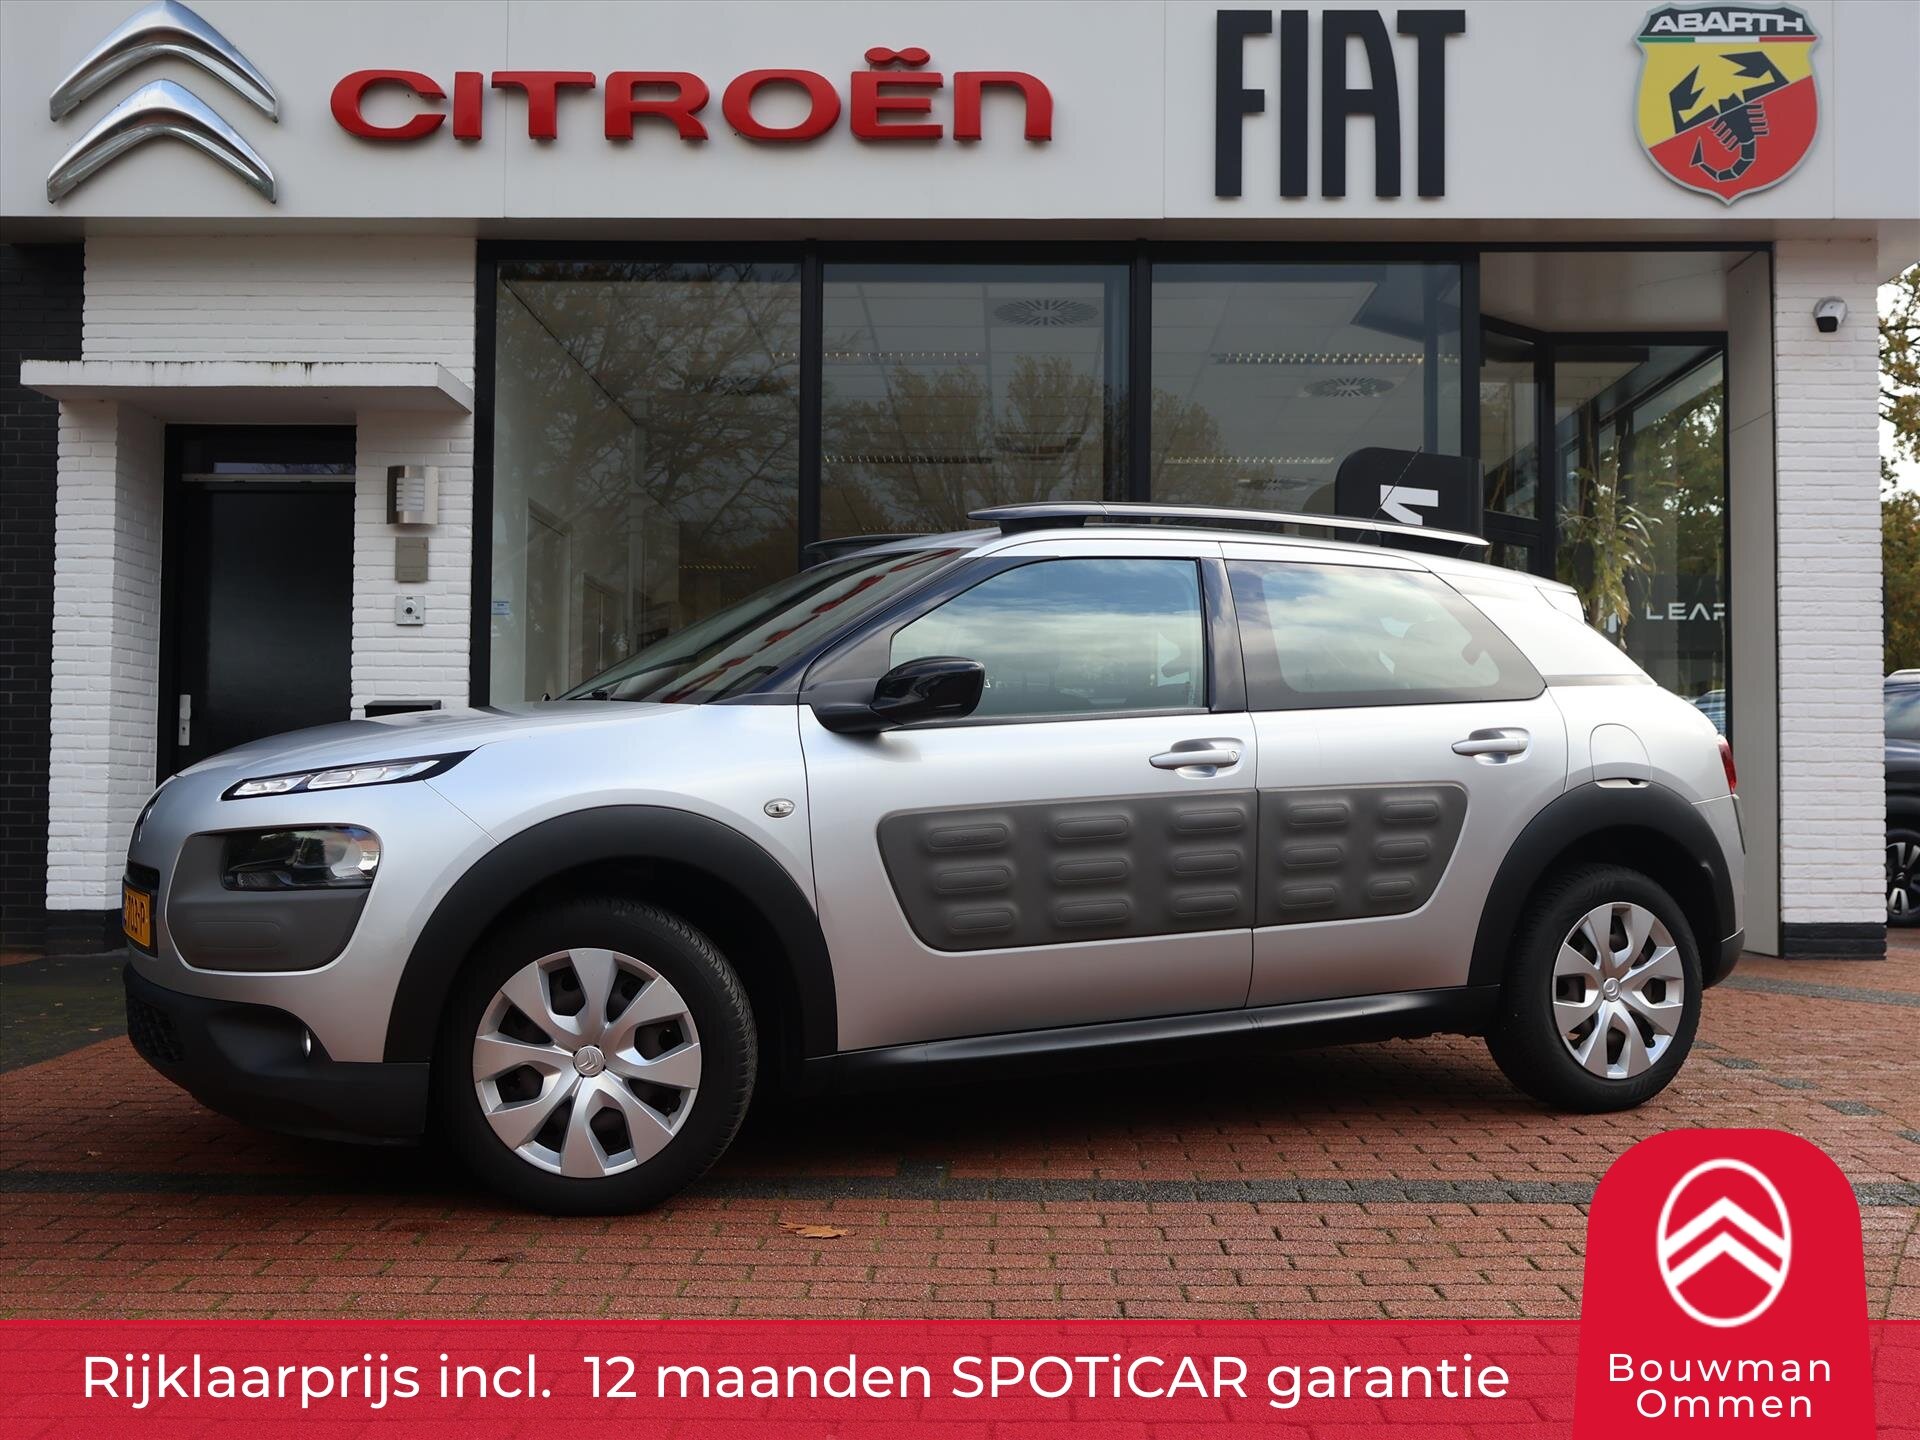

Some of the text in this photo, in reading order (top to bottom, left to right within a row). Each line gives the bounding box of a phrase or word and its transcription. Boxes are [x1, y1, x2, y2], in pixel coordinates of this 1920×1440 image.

[1650, 11, 1804, 33] ABARTH
[330, 46, 1054, 143] CITROËN
[1215, 9, 1466, 198] FIAT
